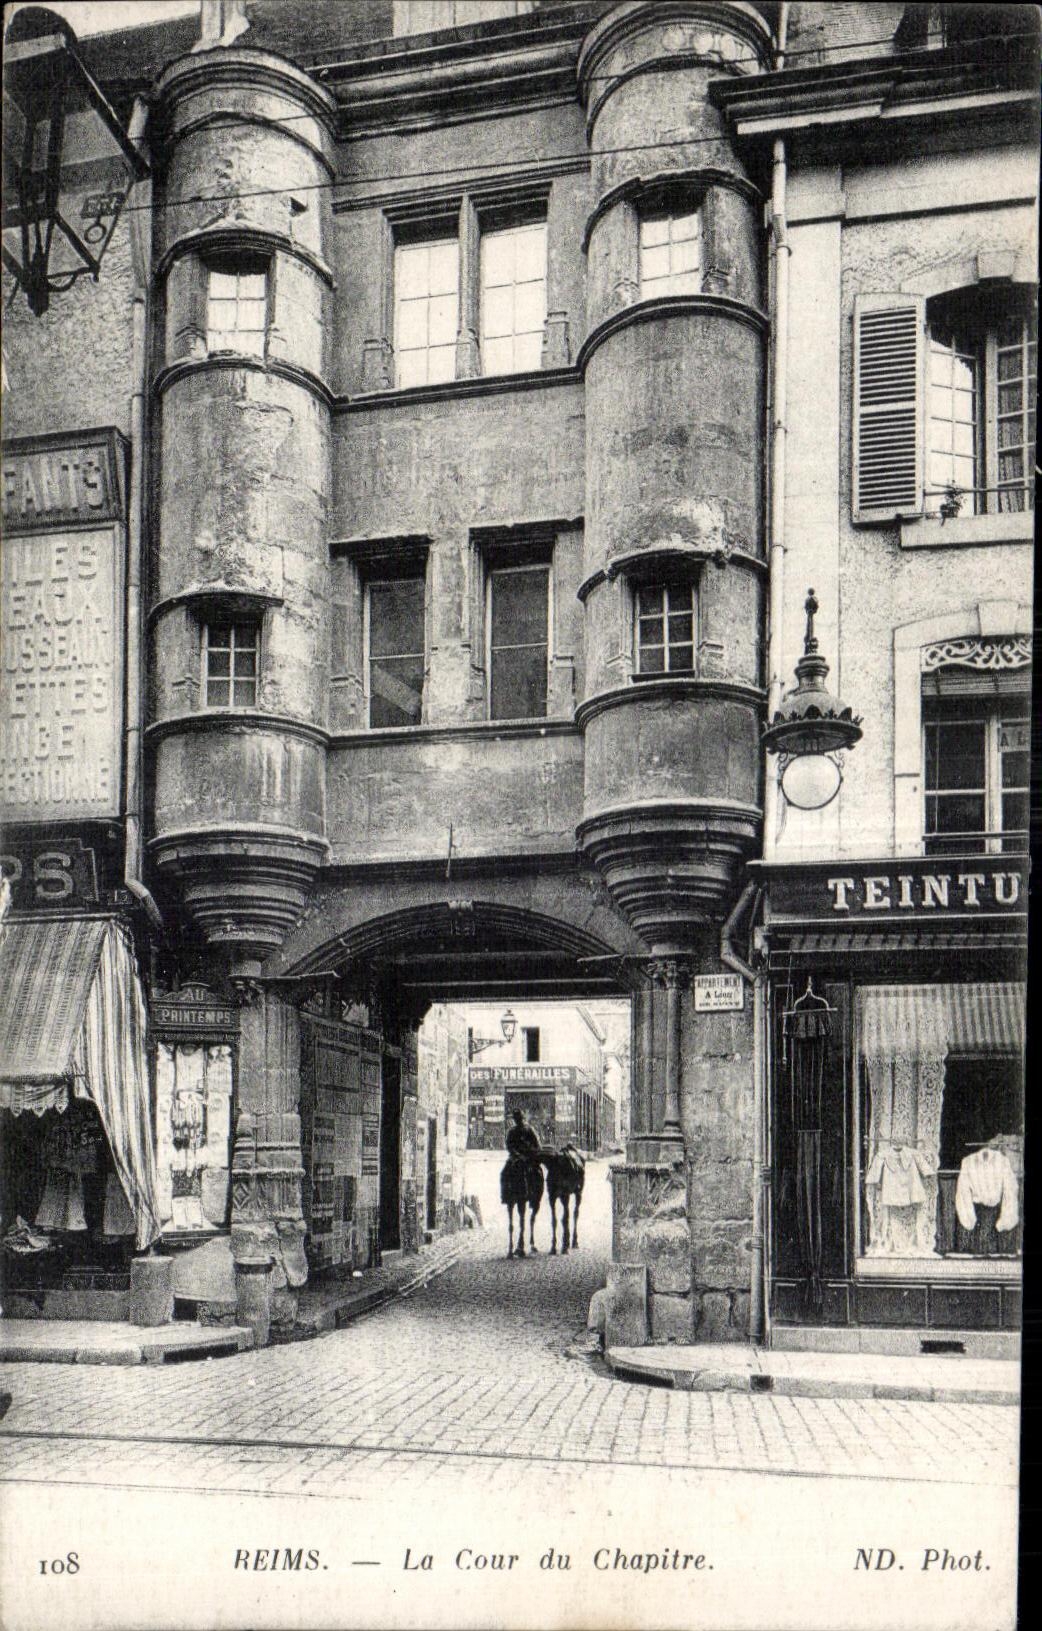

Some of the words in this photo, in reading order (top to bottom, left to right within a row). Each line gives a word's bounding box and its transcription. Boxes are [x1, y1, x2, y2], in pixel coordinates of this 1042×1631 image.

[827, 872, 1021, 910] TEINTU
[181, 987, 207, 1002] AU
[161, 1008, 231, 1024] PRINTEMPS
[470, 1070, 490, 1080] DES
